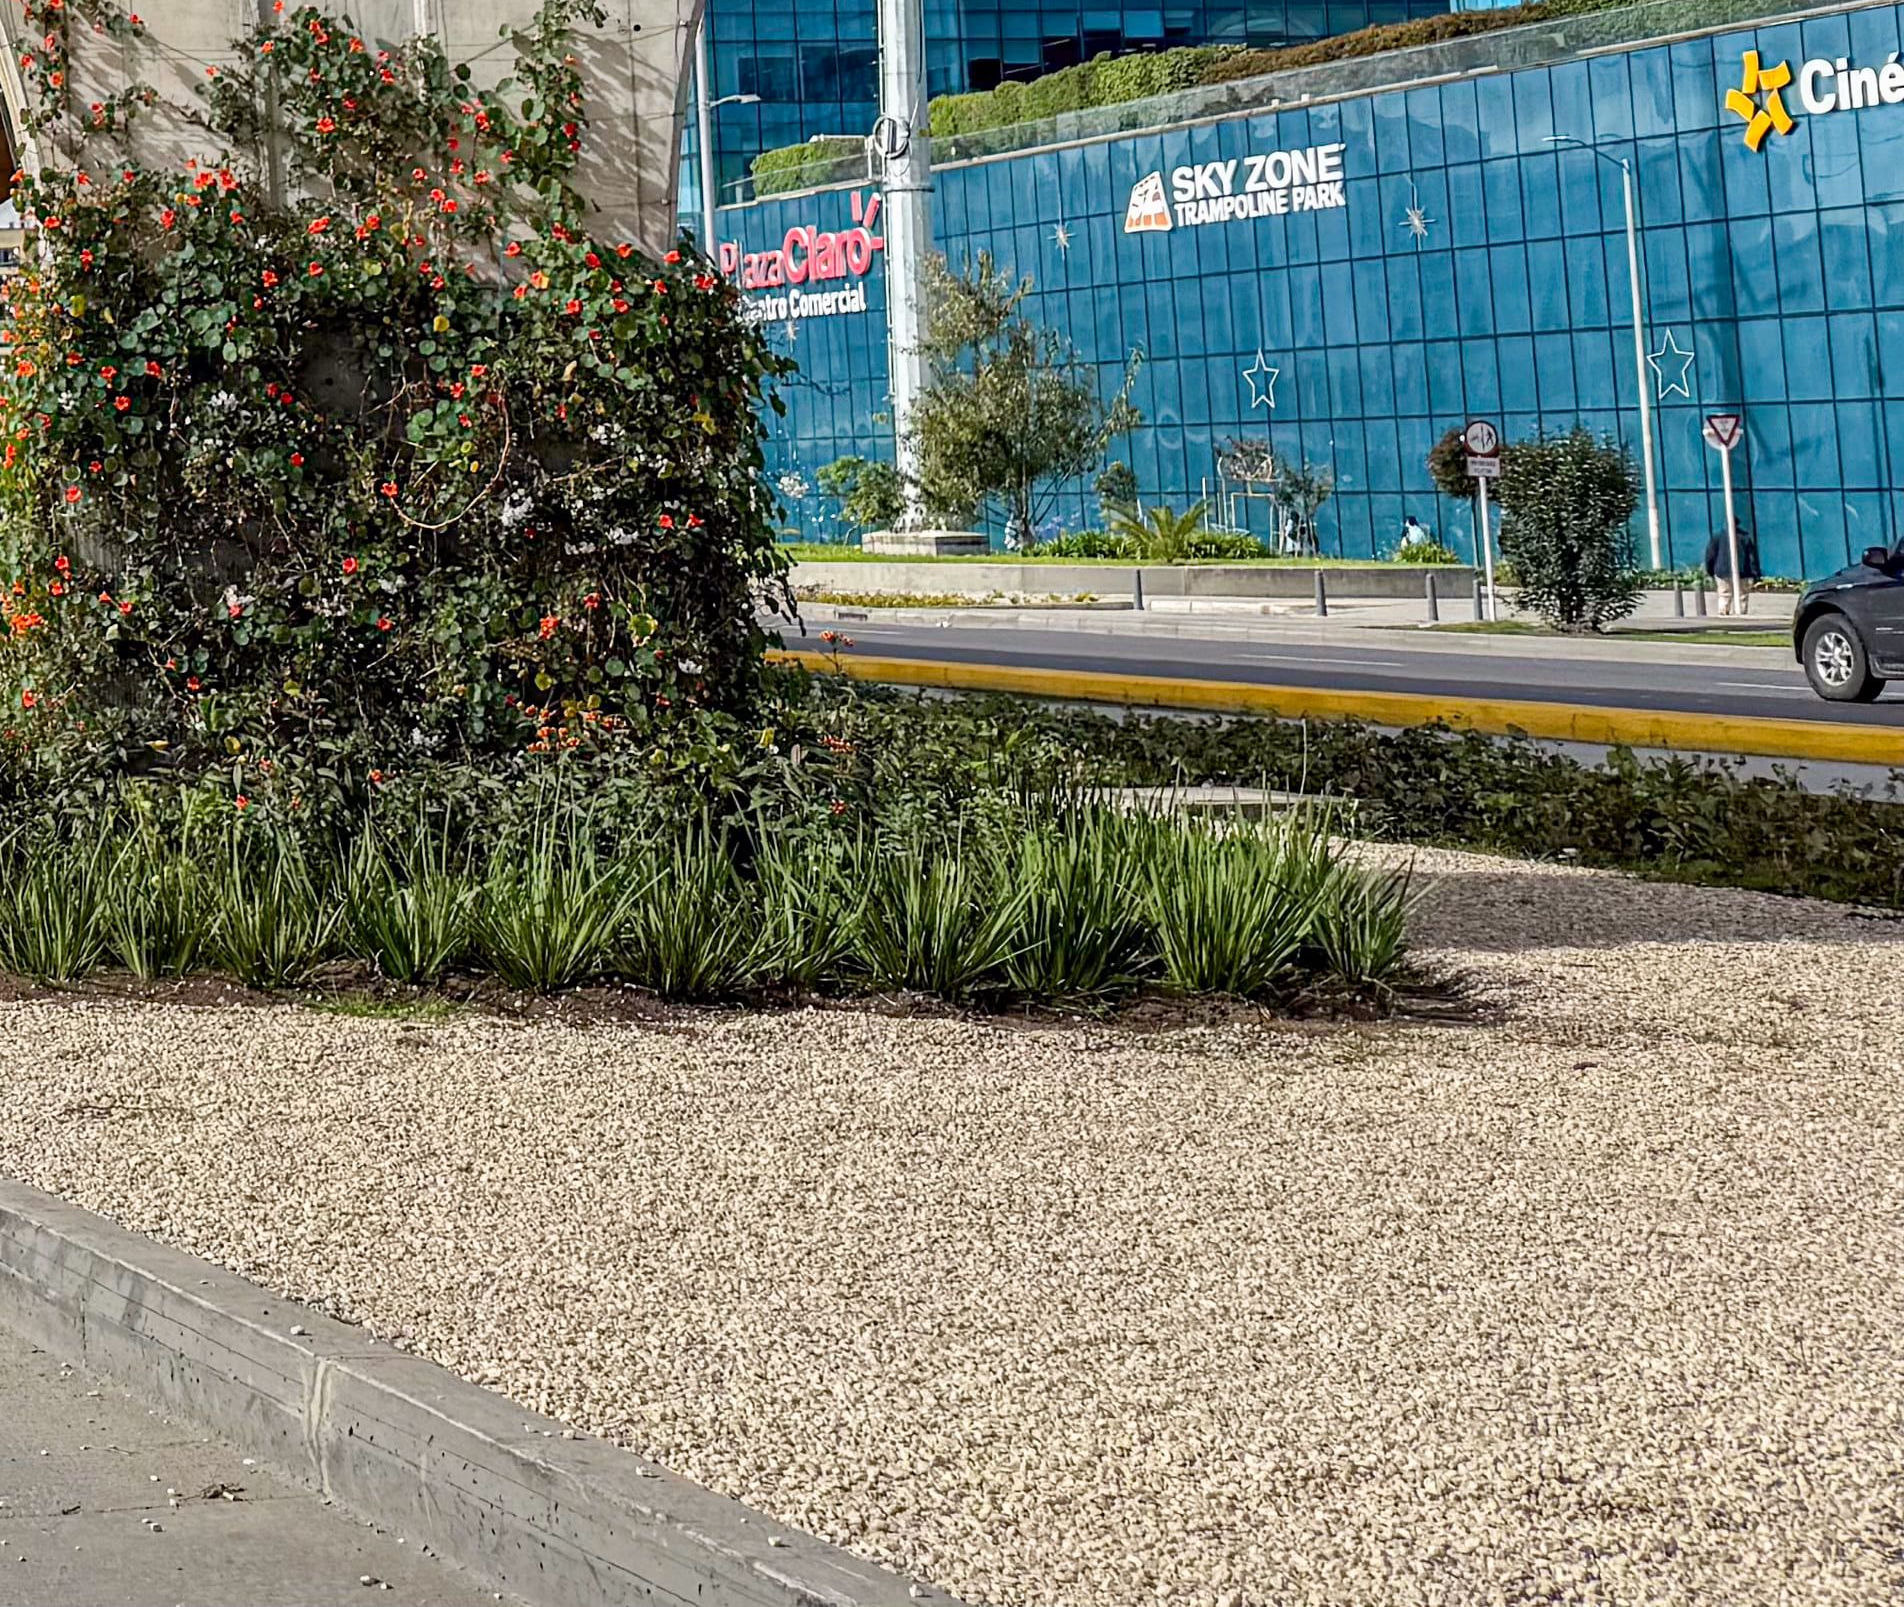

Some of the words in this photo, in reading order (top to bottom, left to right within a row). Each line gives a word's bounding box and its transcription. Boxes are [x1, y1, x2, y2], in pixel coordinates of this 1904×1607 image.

[1800, 51, 1904, 115] Ciné
[1172, 159, 1237, 202] SKY
[1244, 143, 1344, 193] ZONE
[1174, 189, 1290, 227] TRAMPOLINE
[1293, 181, 1346, 212] PARK
[790, 281, 866, 319] Comercial
